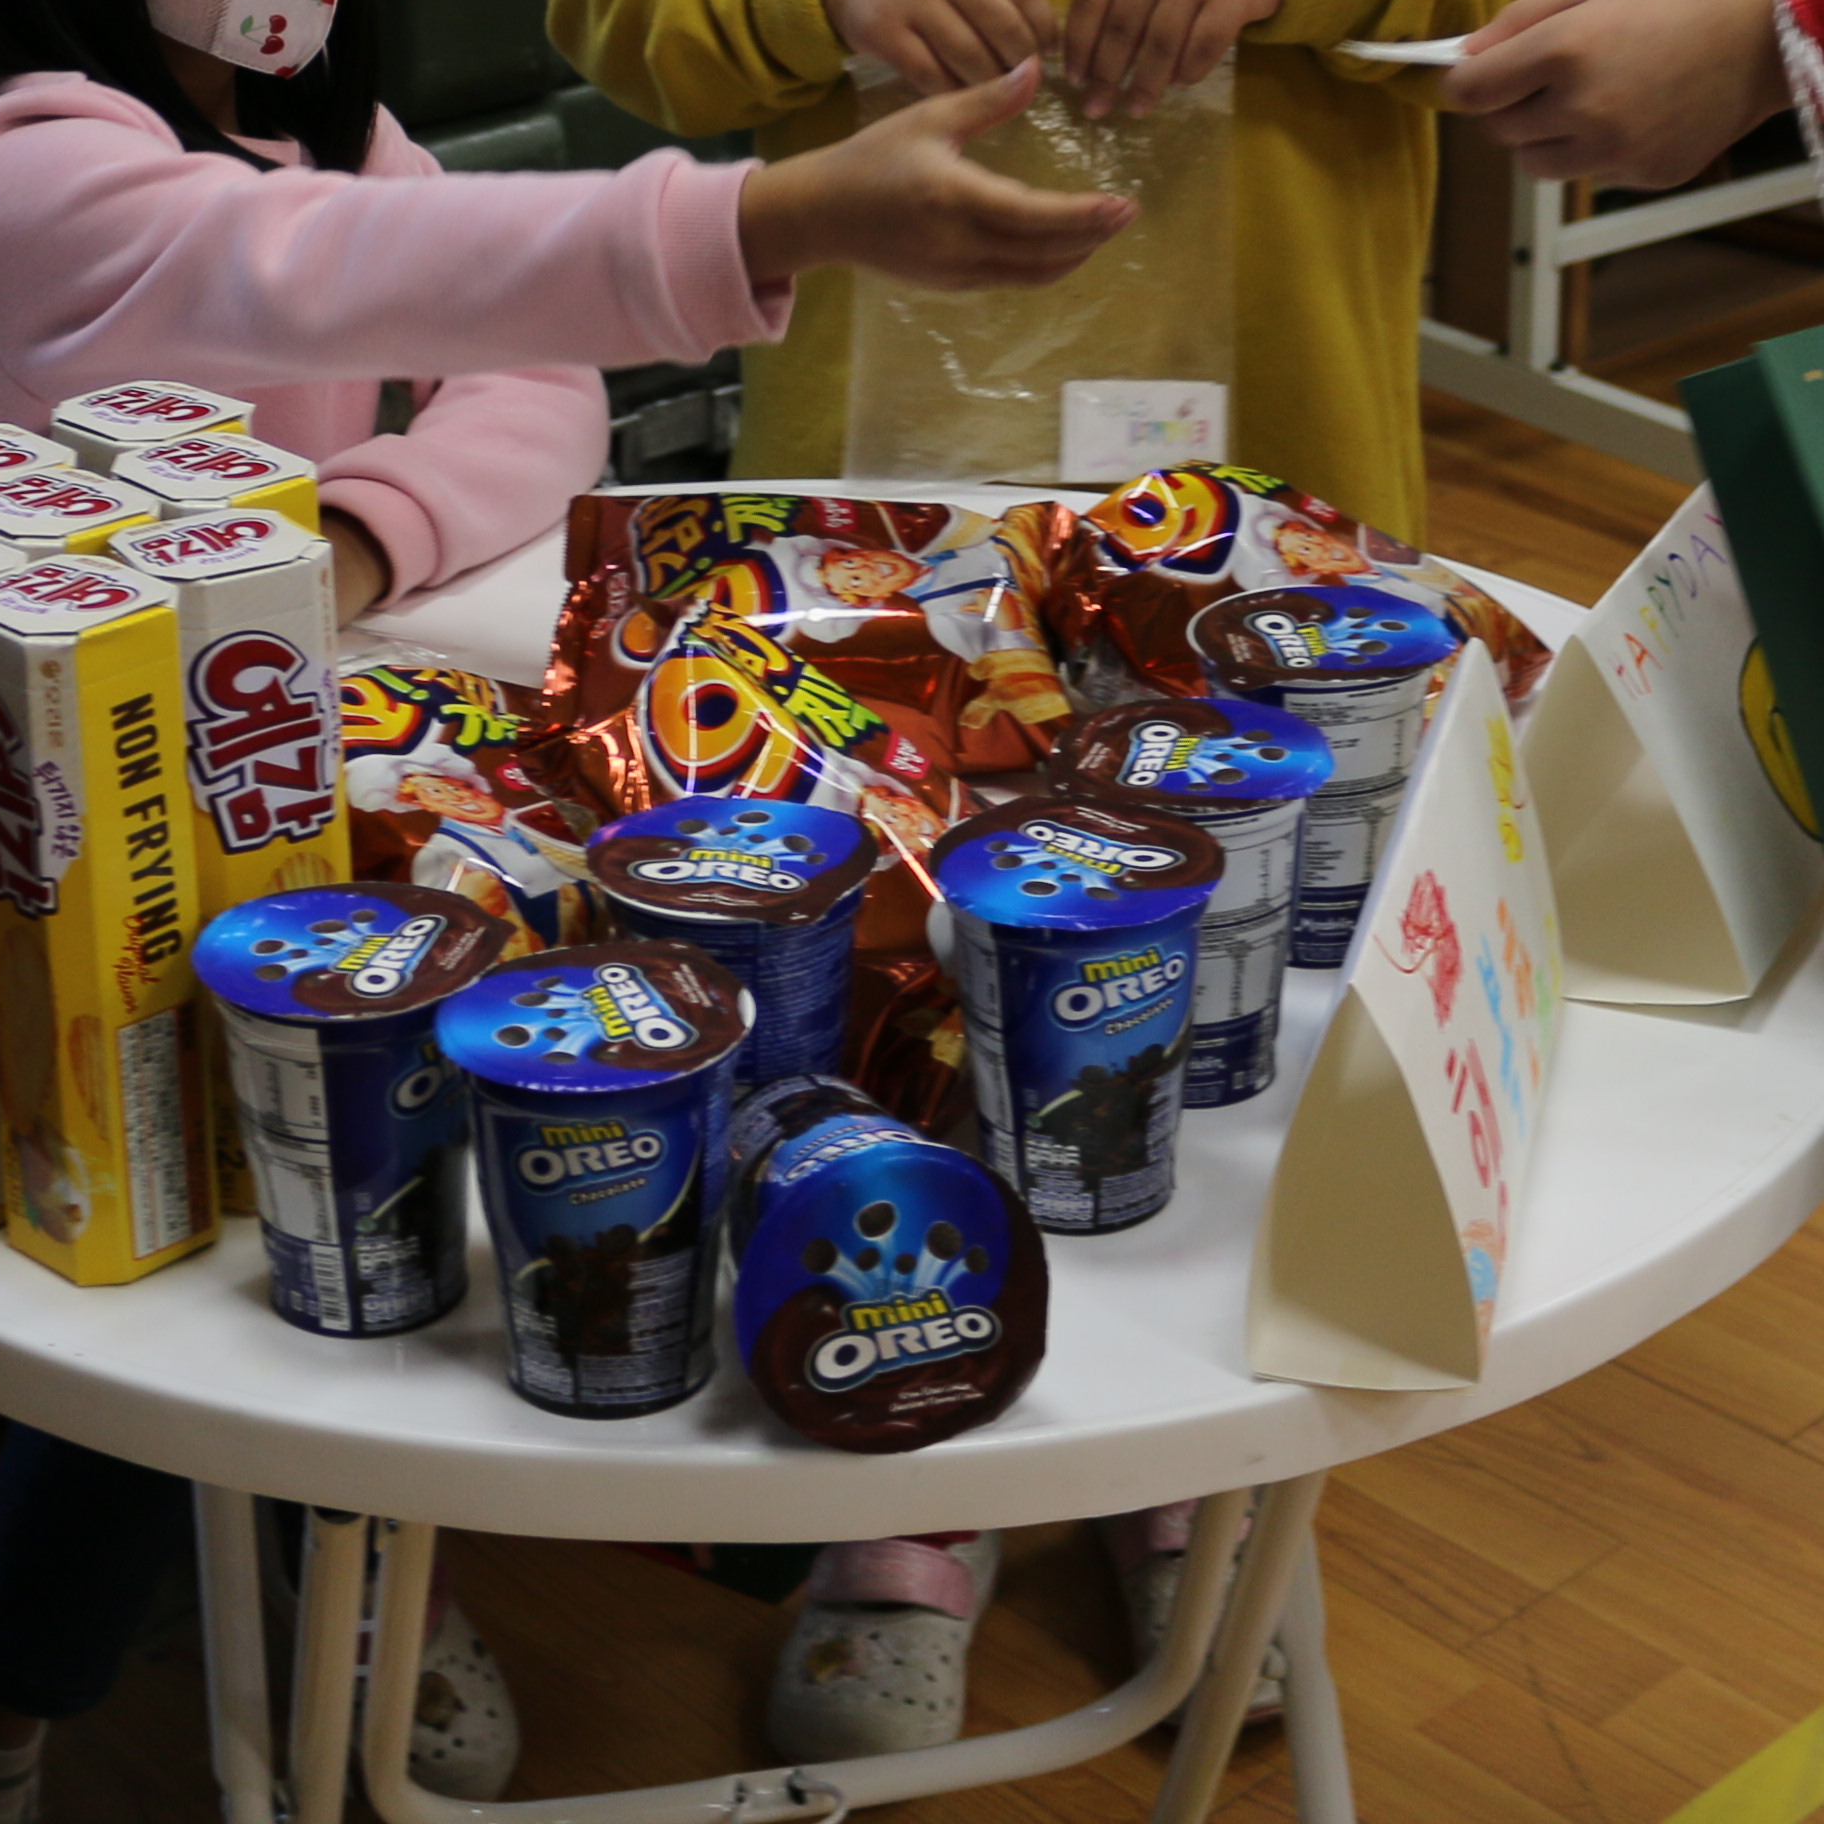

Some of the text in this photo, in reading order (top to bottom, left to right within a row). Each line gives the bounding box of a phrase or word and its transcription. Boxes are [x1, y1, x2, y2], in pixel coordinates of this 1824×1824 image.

[83, 386, 214, 422] 예감
[148, 439, 277, 480] 예감
[141, 519, 275, 564] 예감
[1253, 613, 1311, 667] OREO
[1297, 626, 1327, 656] mini
[111, 696, 163, 787] NON
[187, 631, 340, 854] 예감
[1125, 723, 1182, 786] OREO
[1164, 736, 1202, 771] mini
[688, 850, 771, 871] mini
[1025, 822, 1182, 868] OREO
[1045, 843, 1122, 875] mini
[121, 793, 182, 967] FRYING
[633, 859, 805, 892] OREO
[334, 935, 388, 973] mini
[353, 917, 442, 993] OREO
[1084, 948, 1159, 980] mini
[598, 965, 693, 1047] OREO
[1054, 956, 1185, 1021] OREO
[581, 989, 632, 1039] mini
[1105, 998, 1174, 1034] Chocolate
[518, 1130, 663, 1183] OREO
[542, 1124, 623, 1146] mini
[571, 1177, 648, 1204] Chocolate
[852, 1293, 947, 1329] mini
[811, 1312, 996, 1389] OREO
